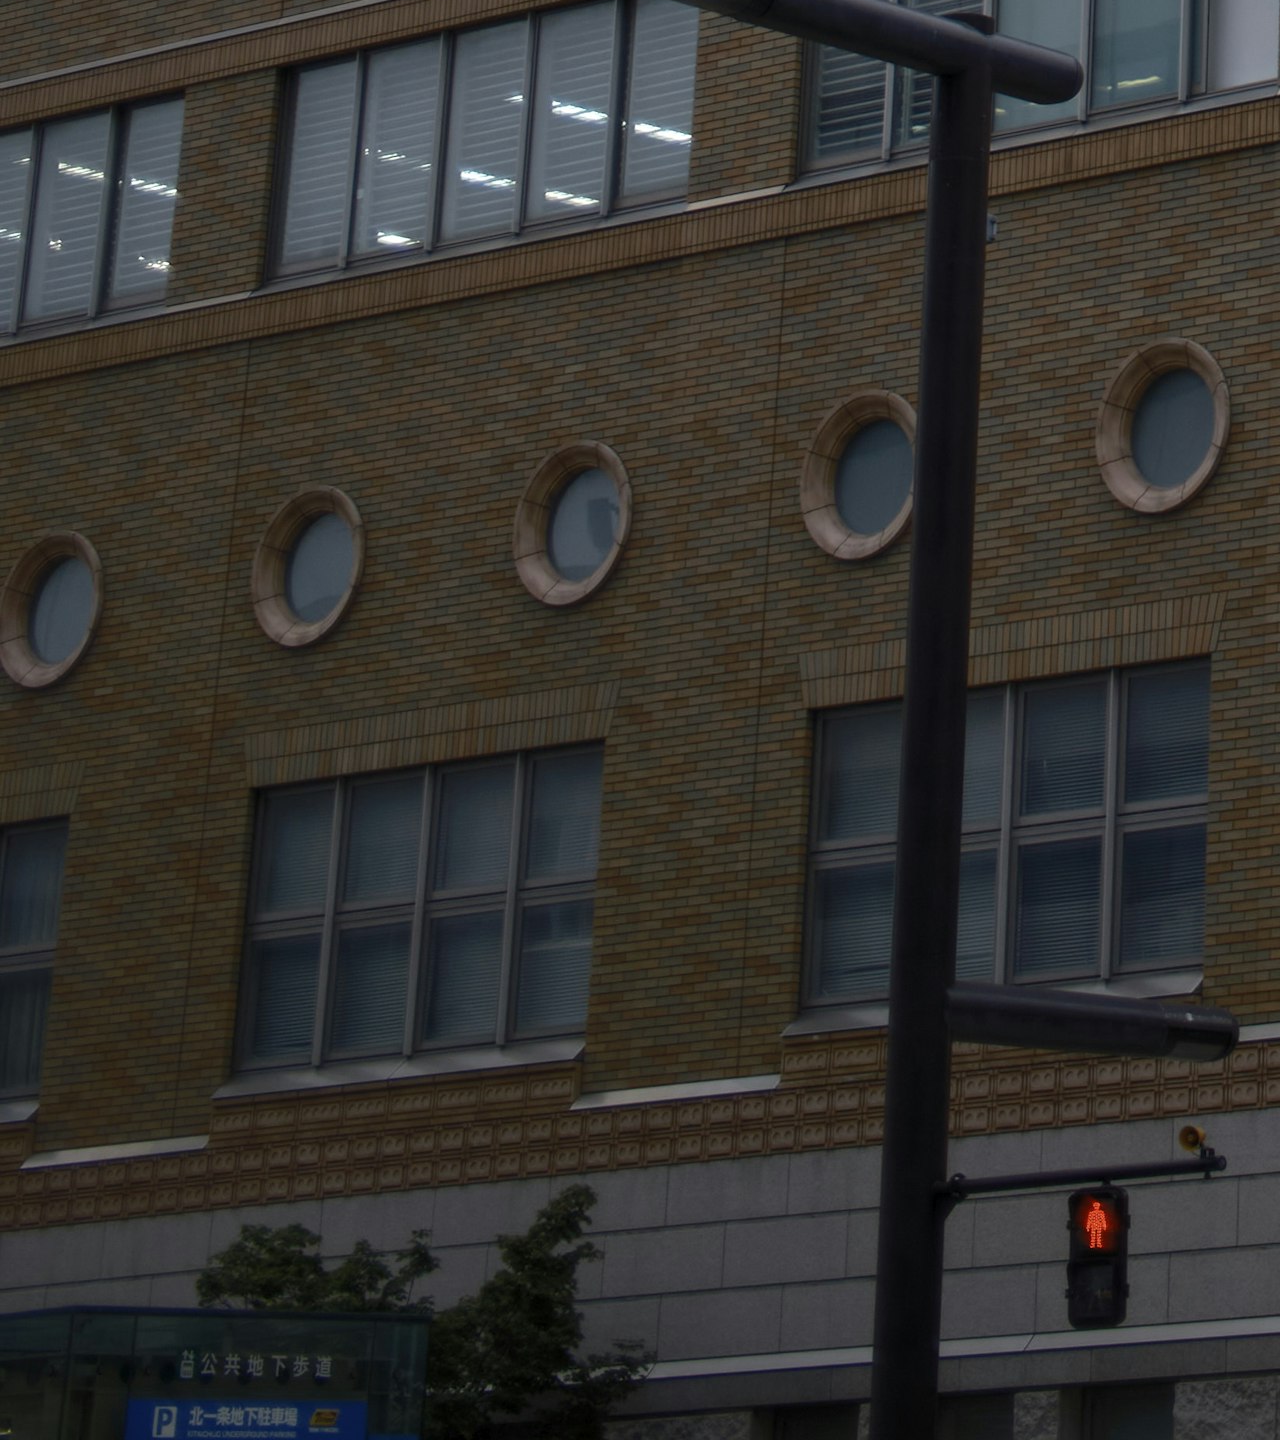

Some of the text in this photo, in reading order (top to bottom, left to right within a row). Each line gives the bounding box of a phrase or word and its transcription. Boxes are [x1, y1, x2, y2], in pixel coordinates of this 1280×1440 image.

[201, 1352, 333, 1378] 公共地下歩道
